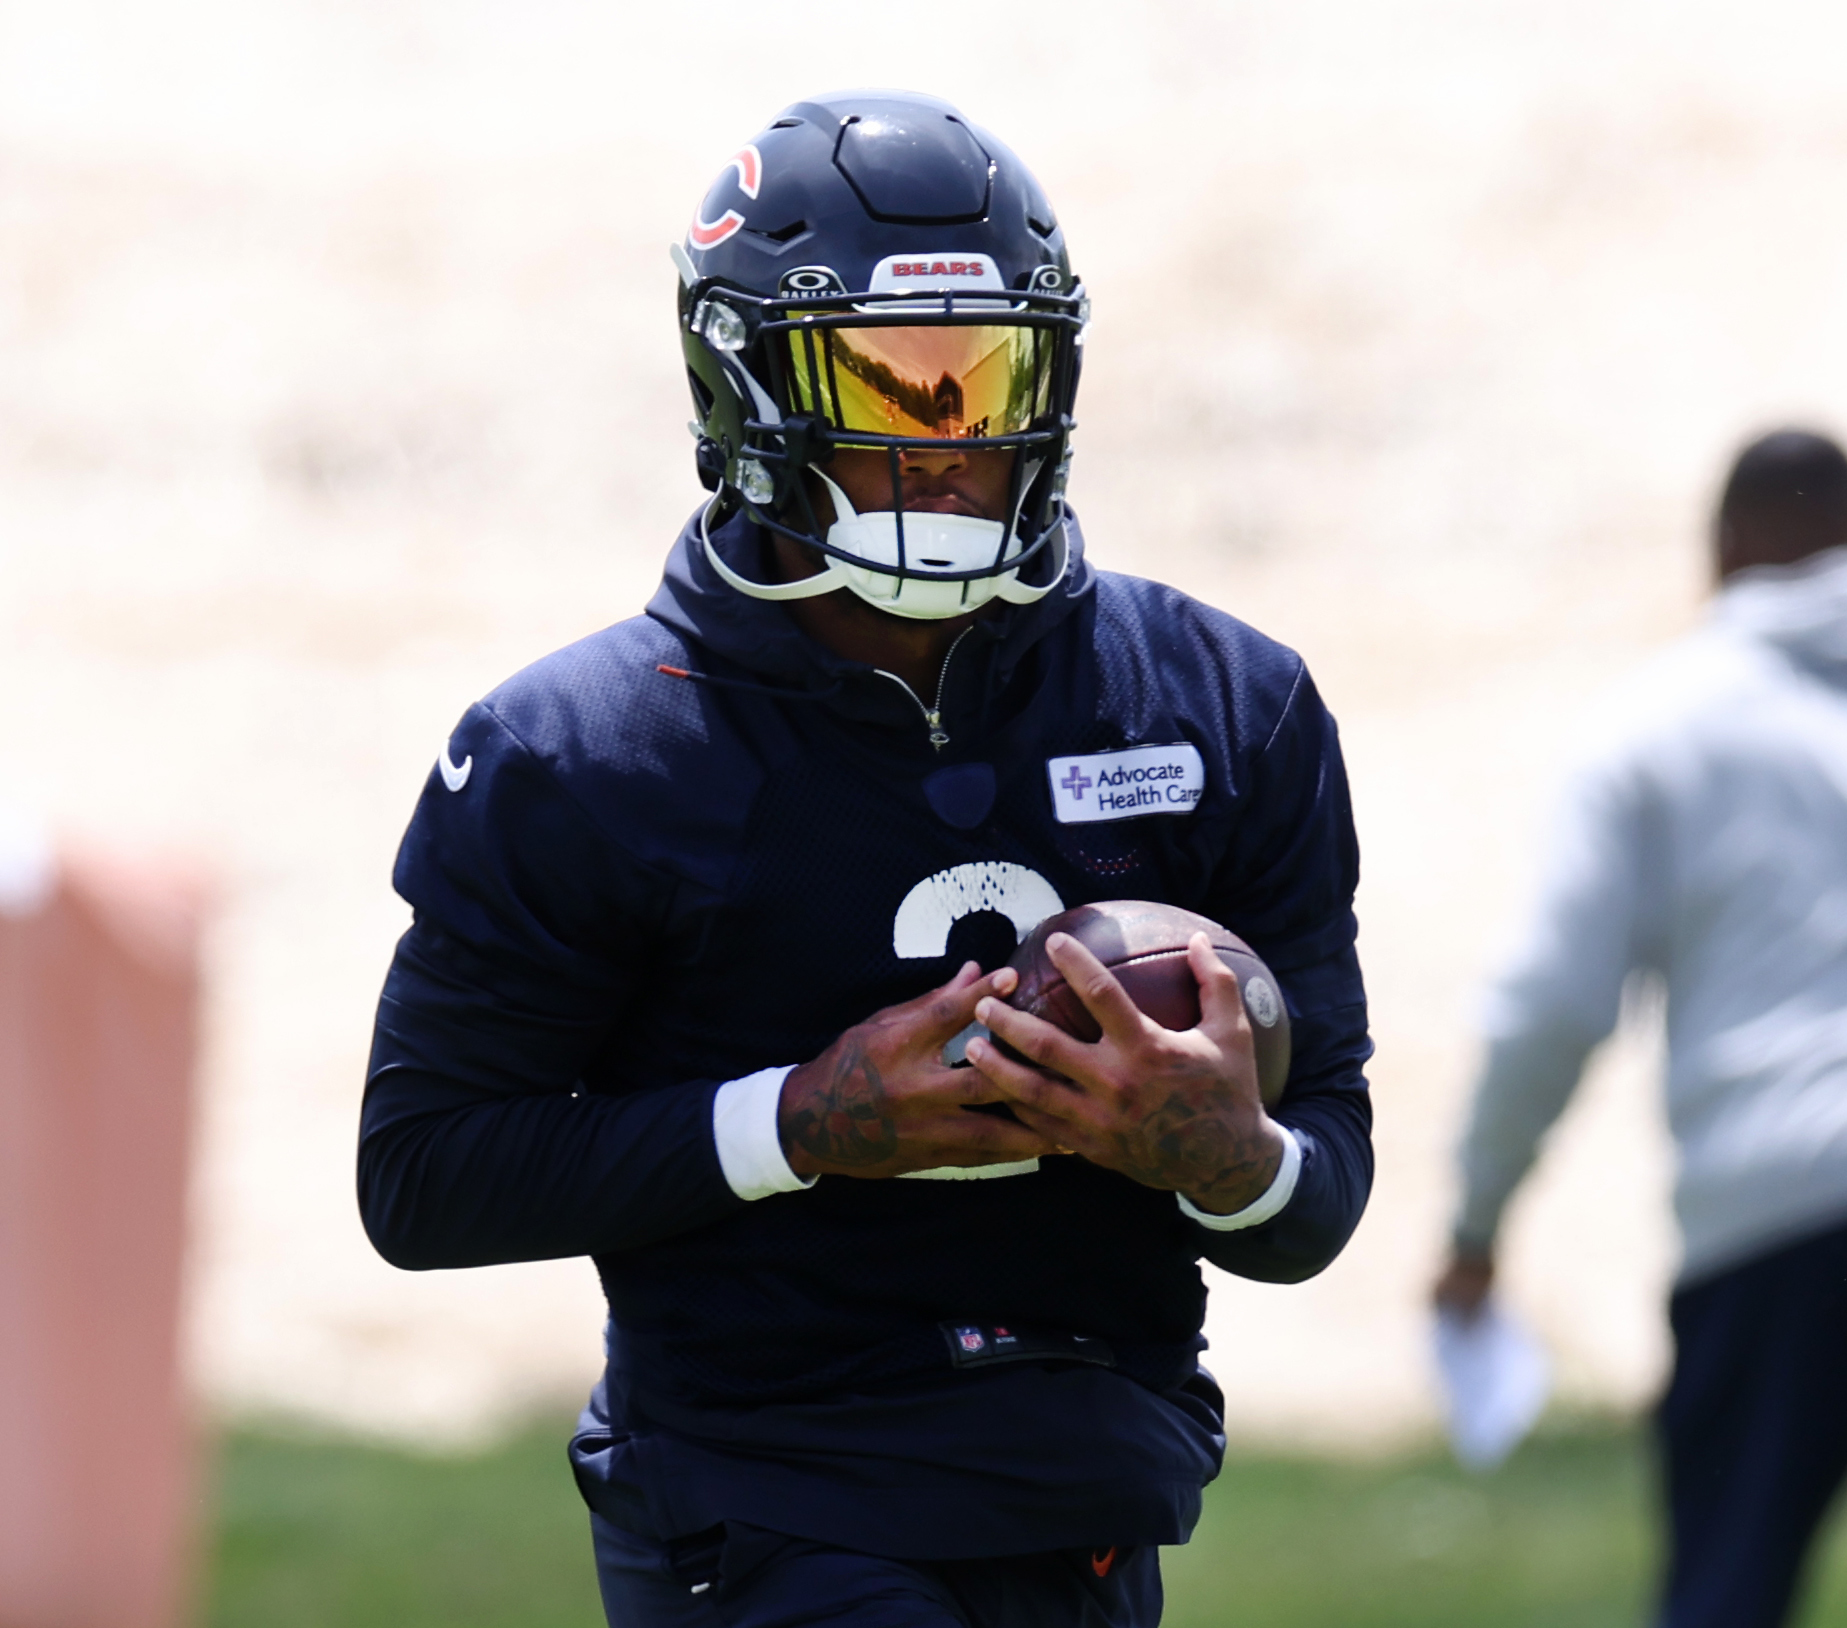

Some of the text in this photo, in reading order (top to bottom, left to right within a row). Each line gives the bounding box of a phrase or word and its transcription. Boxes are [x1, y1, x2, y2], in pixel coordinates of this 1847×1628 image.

[892, 261, 984, 277] BEARS
[1097, 763, 1184, 788] Advocate
[1098, 785, 1162, 811] Health
